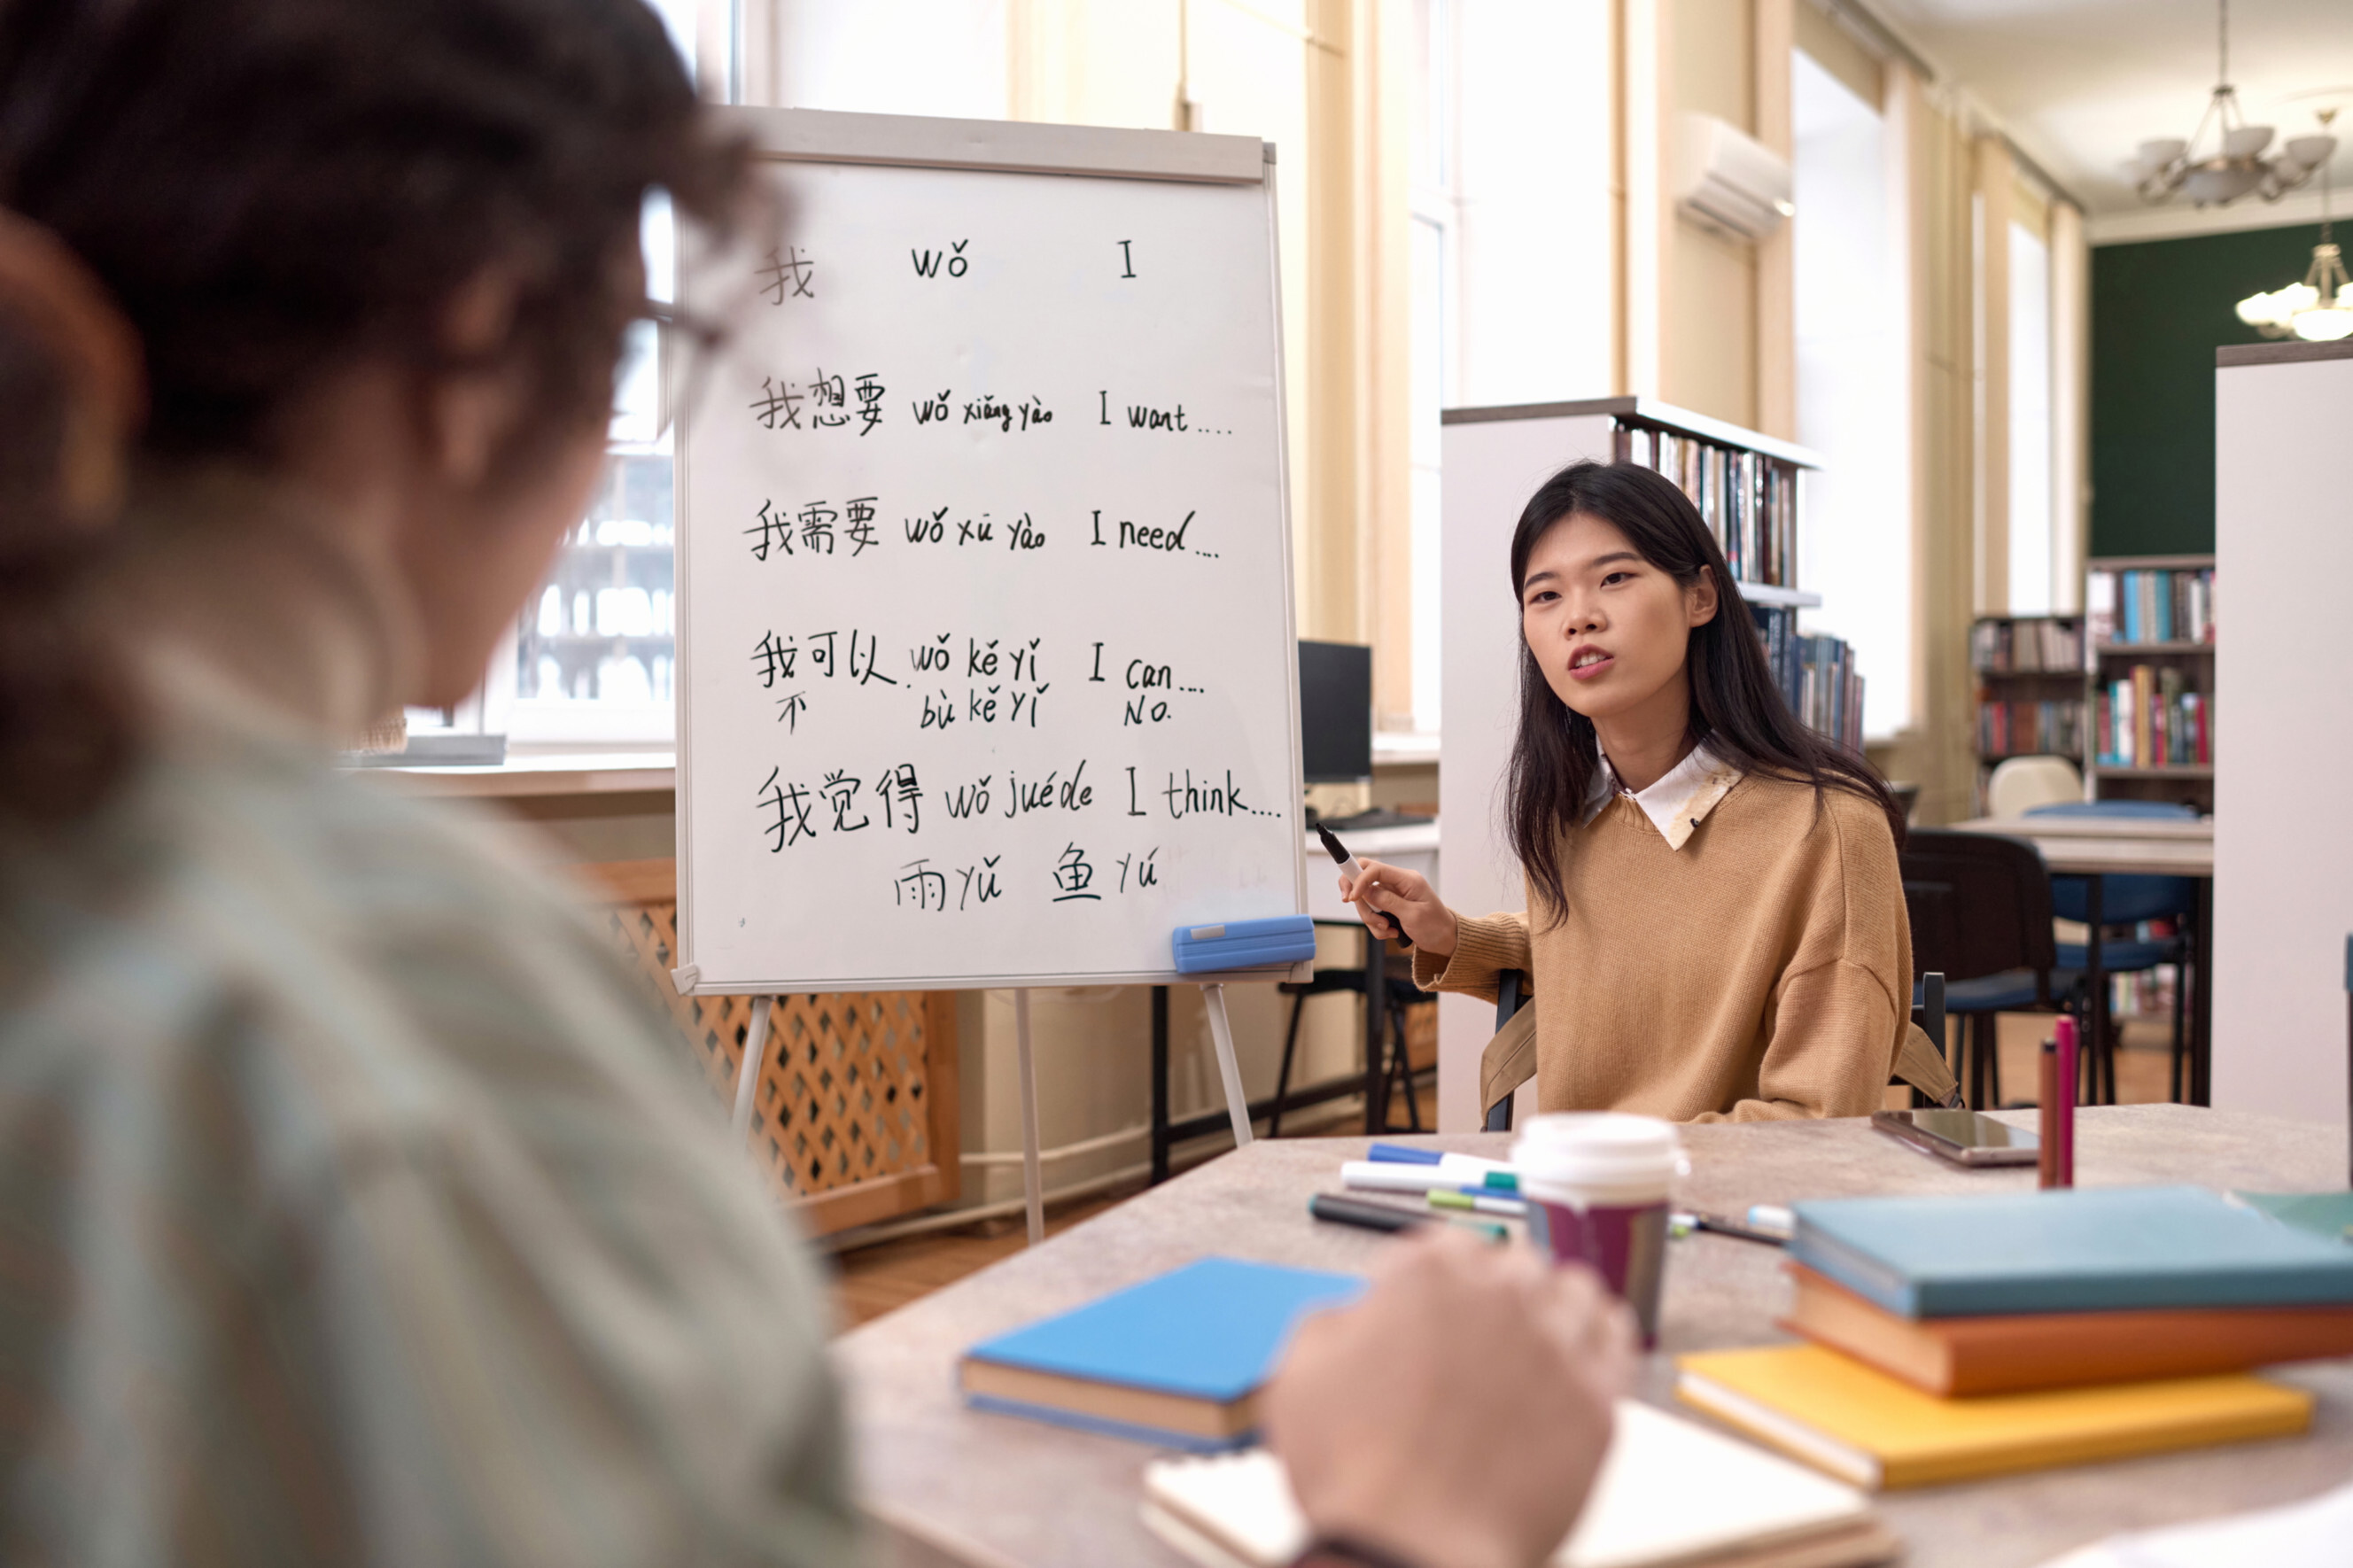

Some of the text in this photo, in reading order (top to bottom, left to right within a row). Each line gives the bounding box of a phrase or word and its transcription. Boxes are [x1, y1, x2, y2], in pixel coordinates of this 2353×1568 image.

[753, 238, 1138, 306] 我 wǒ I
[749, 367, 886, 437] 我想要
[912, 388, 952, 426] wǒ
[1099, 389, 1113, 426] I
[742, 495, 880, 563] 我需要
[904, 505, 950, 544] wǒ
[1090, 508, 1107, 547] I
[909, 632, 951, 672] wǒ
[1088, 641, 1107, 683] I
[775, 690, 807, 735] 不
[756, 763, 924, 854] 我觉得
[944, 774, 992, 819] wǒ
[1124, 765, 1147, 818] I
[893, 858, 947, 912] 雨
[1052, 841, 1102, 904] 鱼
